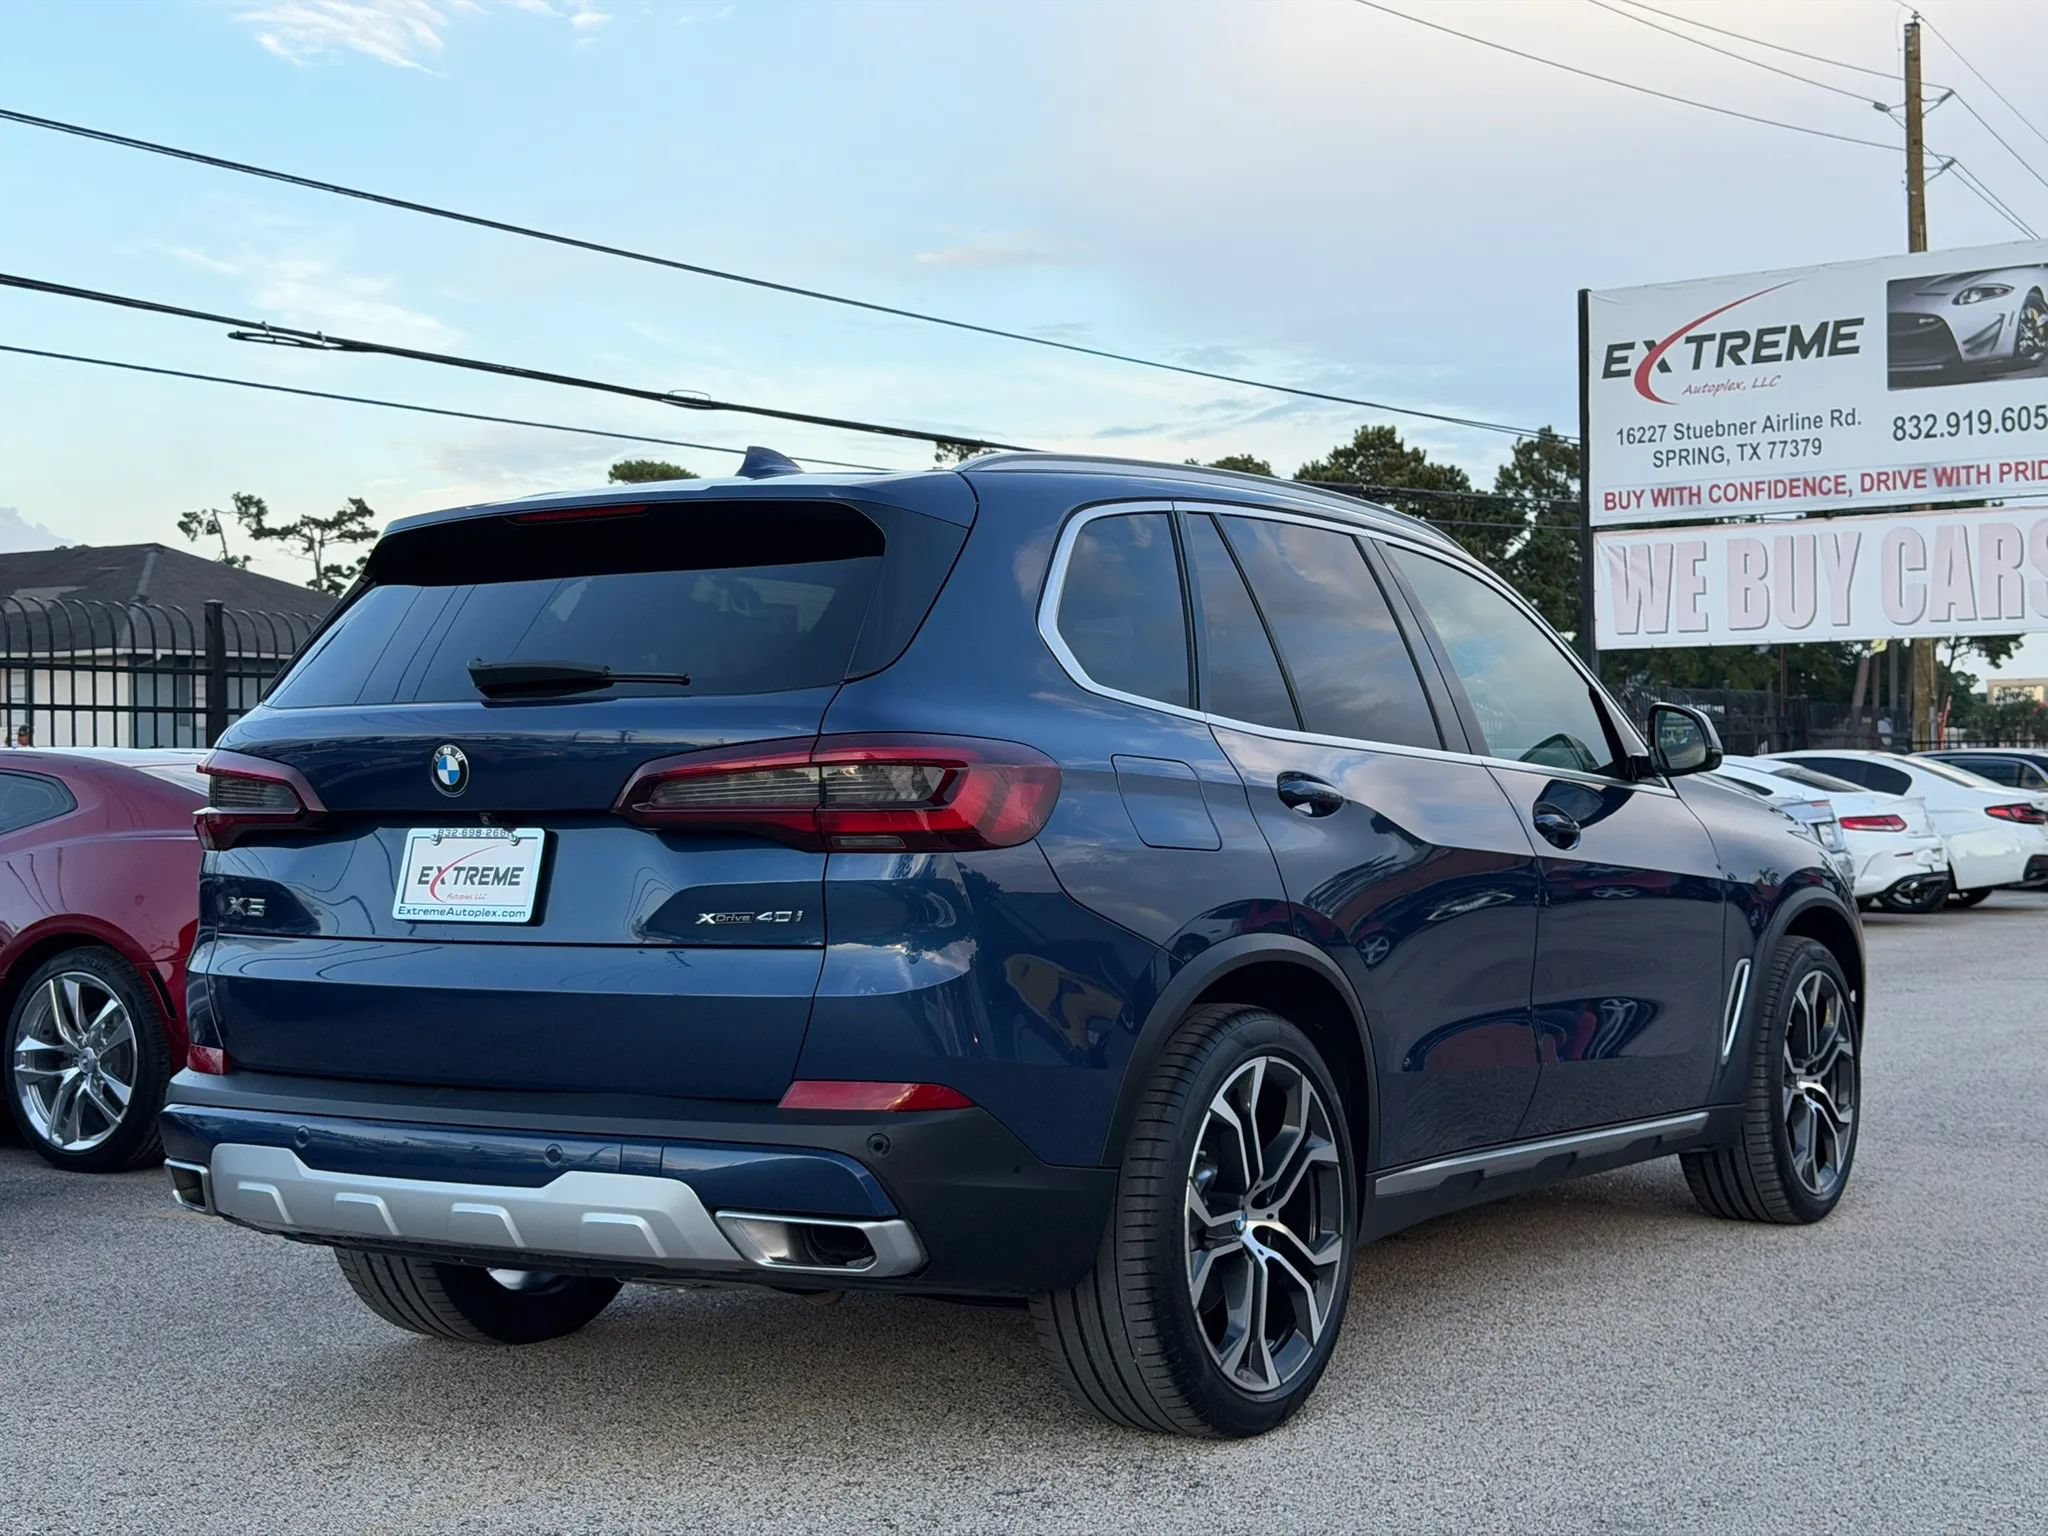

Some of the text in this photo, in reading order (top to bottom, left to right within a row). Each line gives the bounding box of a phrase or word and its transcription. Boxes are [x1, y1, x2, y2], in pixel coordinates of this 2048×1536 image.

[1601, 316, 1866, 381] EXTREME
[1681, 374, 1782, 397] Autoplex, LLC
[1616, 407, 1863, 446] 16227 Stuebner Airline Rd.
[1652, 437, 1823, 469] SPRING, TX 77379
[1603, 488, 1646, 512] BUY
[1650, 484, 1702, 508] WITH
[1708, 474, 1854, 505] CONFIDENCE,
[1860, 467, 1928, 493] DRIVE
[1933, 463, 1991, 488] WITH
[1607, 540, 1709, 636] WE
[1726, 531, 1862, 631] BUY
[417, 866, 525, 887] EXTREME
[397, 905, 526, 919] ExtremeAutoplex.com
